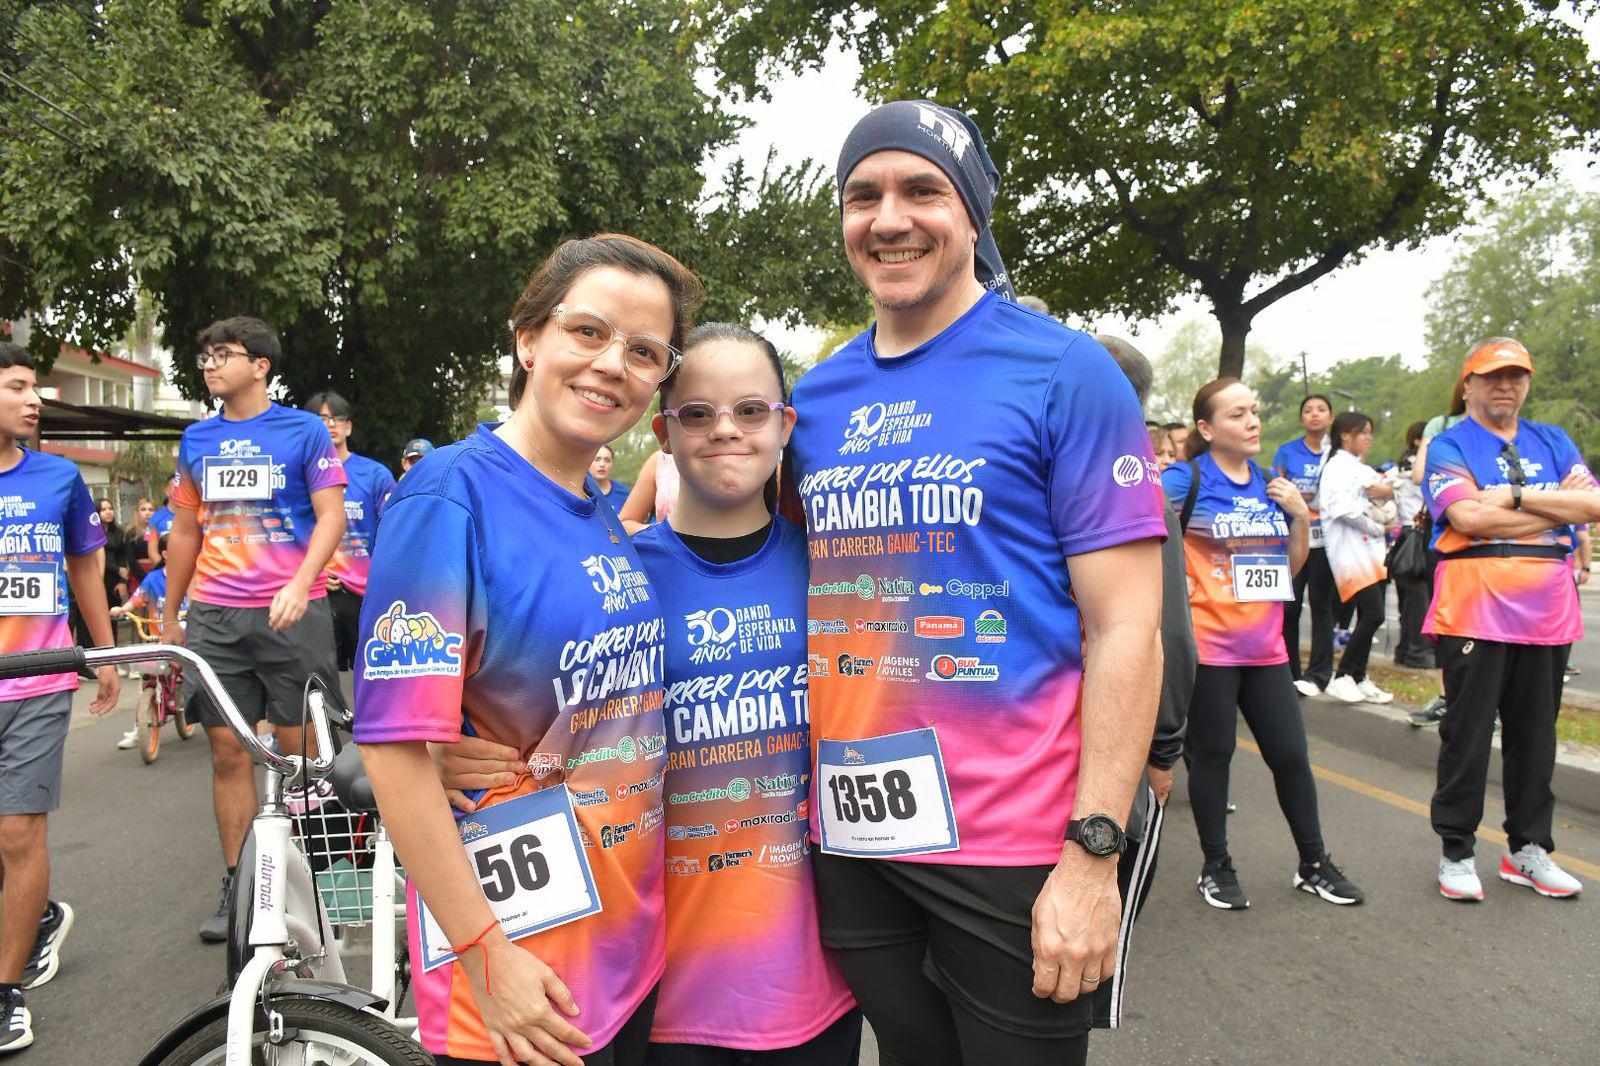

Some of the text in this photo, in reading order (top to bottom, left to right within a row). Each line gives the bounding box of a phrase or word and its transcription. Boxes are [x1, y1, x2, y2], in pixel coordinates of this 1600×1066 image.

[887, 400, 916, 417] DANDO
[844, 402, 886, 438] 50
[882, 413, 932, 432] ESPERANZA
[839, 435, 878, 456] AÑOS
[878, 429, 912, 446] DE VIDA
[218, 469, 258, 488] 1229
[862, 458, 912, 492] POR
[912, 453, 986, 484] ELLOS
[812, 483, 983, 533] CAMBIA TODO
[1212, 523, 1230, 538] LO
[33, 534, 62, 552] TODO
[833, 534, 884, 558] CARRERA
[887, 531, 955, 554] GANAC-TEC
[581, 555, 621, 594] 50
[1245, 569, 1279, 588] 2357
[0, 577, 40, 598] 256
[946, 578, 1010, 599] Coppel
[736, 604, 771, 623] DANDO
[684, 607, 737, 646] 50
[738, 617, 797, 639] ESPERANZA
[366, 636, 461, 668] GANAC
[560, 624, 635, 672] CORRER
[633, 618, 662, 653] POR
[689, 642, 737, 665] AÑOS
[739, 633, 782, 654] DE VIDA
[957, 659, 978, 668] BUX
[957, 667, 997, 676] PUNTUAL
[733, 664, 791, 702] POR
[673, 692, 787, 744] CAMBIA
[700, 738, 763, 767] CARRERA
[670, 788, 727, 804] ConCrédito
[828, 769, 917, 823] 1358
[474, 834, 550, 902] 56
[260, 854, 276, 912] alurock
[501, 912, 520, 923] honor
